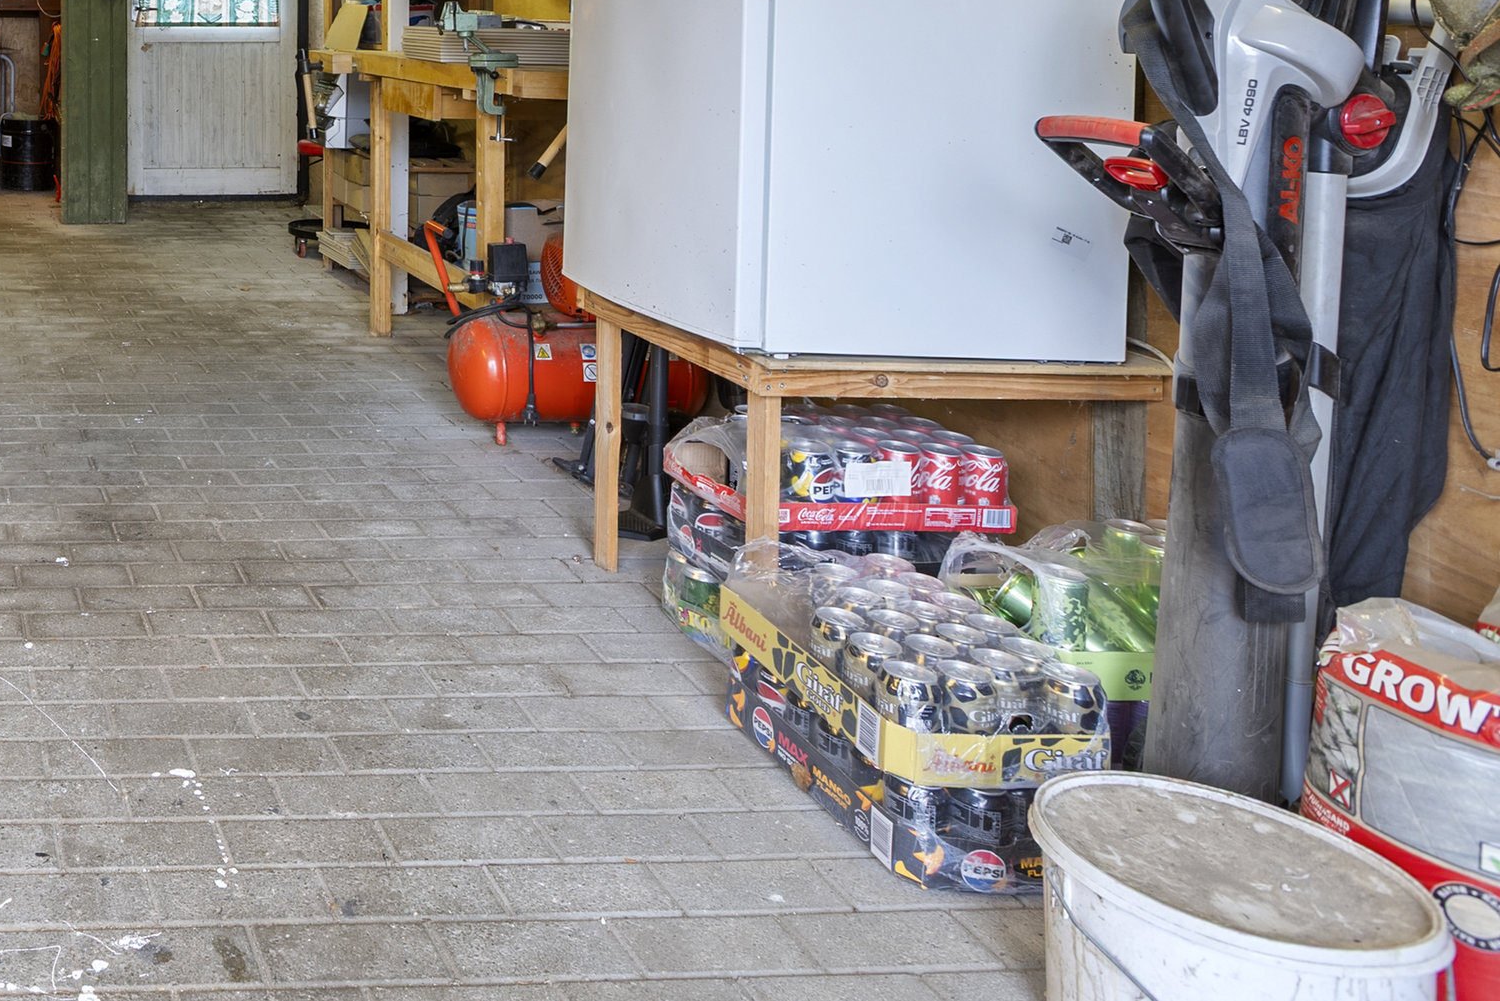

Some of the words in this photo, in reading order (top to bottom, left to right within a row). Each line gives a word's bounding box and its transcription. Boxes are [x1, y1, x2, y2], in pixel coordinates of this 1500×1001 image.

[1236, 118, 1250, 146] LBV
[1243, 79, 1258, 117] 4090
[1278, 136, 1304, 225] AL-KO
[806, 689, 831, 714] GOLD
[753, 716, 774, 738] PEPSI
[778, 730, 809, 768] MAX
[812, 765, 852, 806] MANGO
